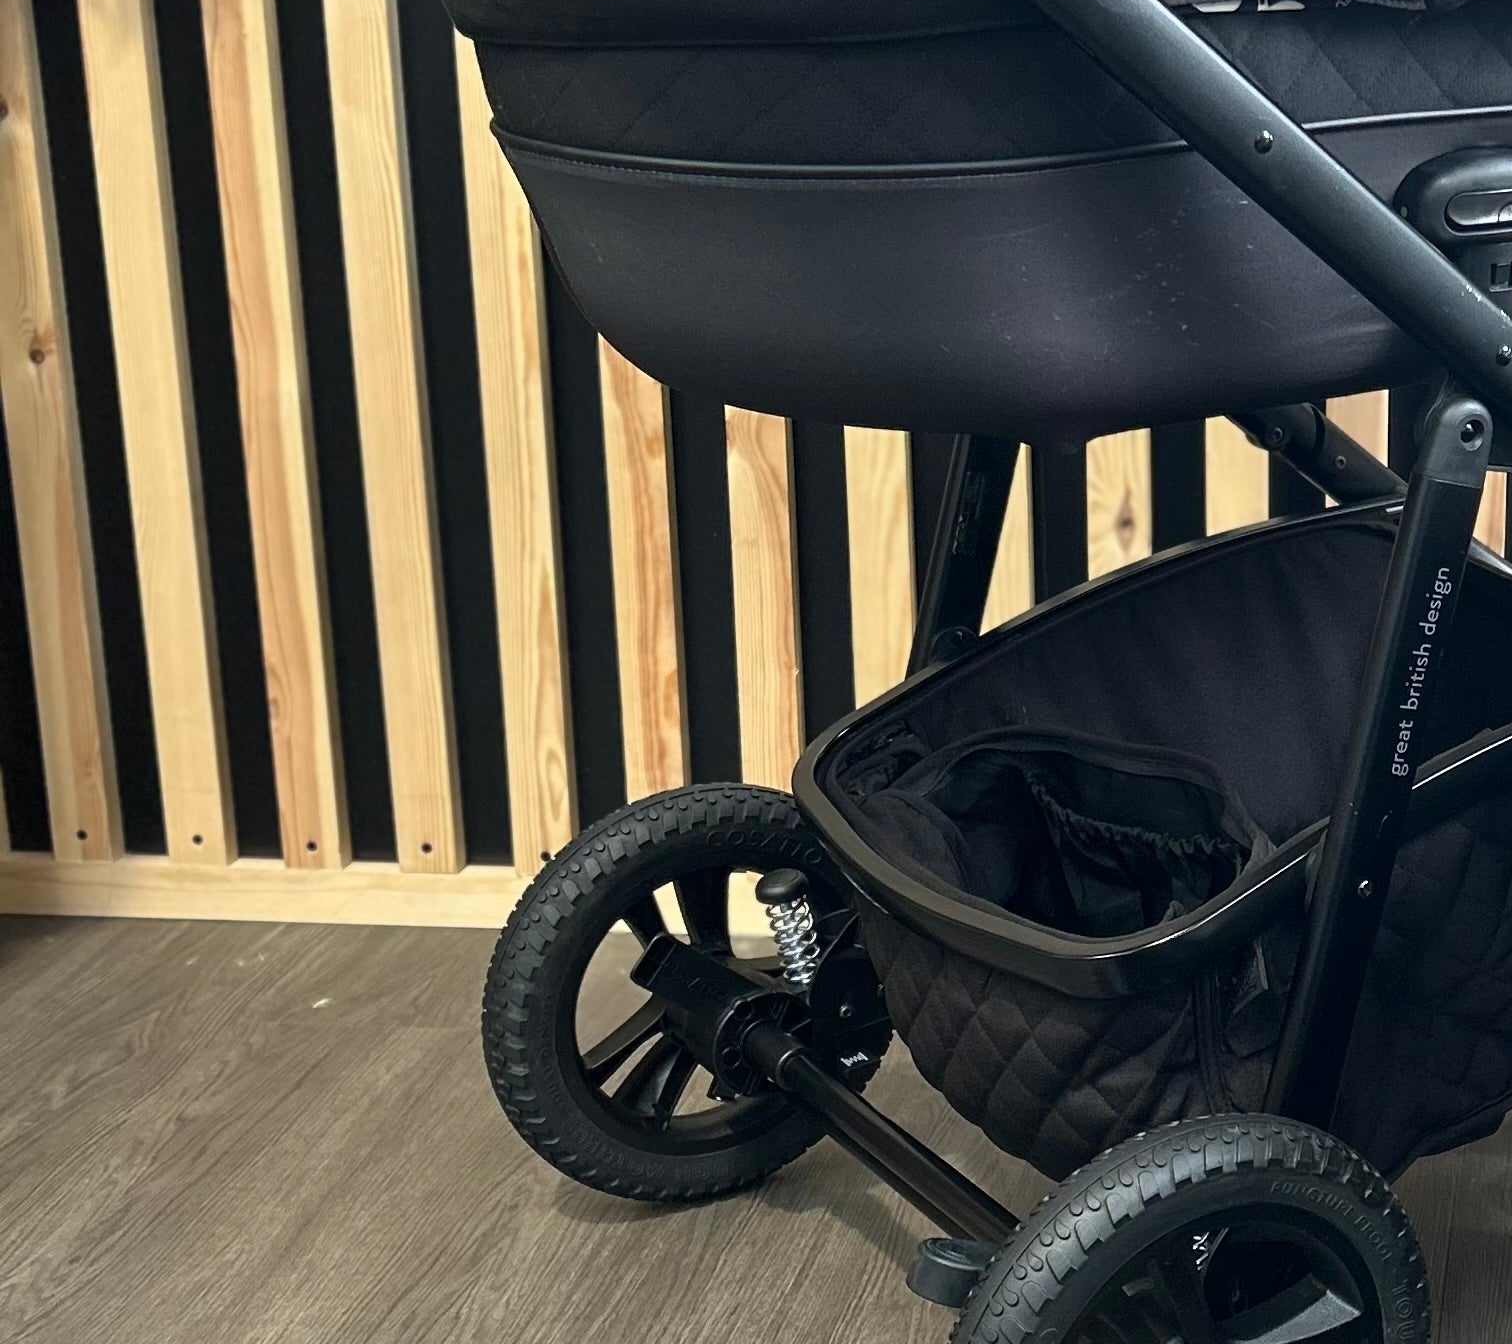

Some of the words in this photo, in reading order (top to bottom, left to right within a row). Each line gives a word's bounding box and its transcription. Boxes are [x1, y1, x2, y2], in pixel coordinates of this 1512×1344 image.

[1418, 566, 1452, 636] design
[1399, 643, 1432, 711] british
[1391, 719, 1414, 777] great
